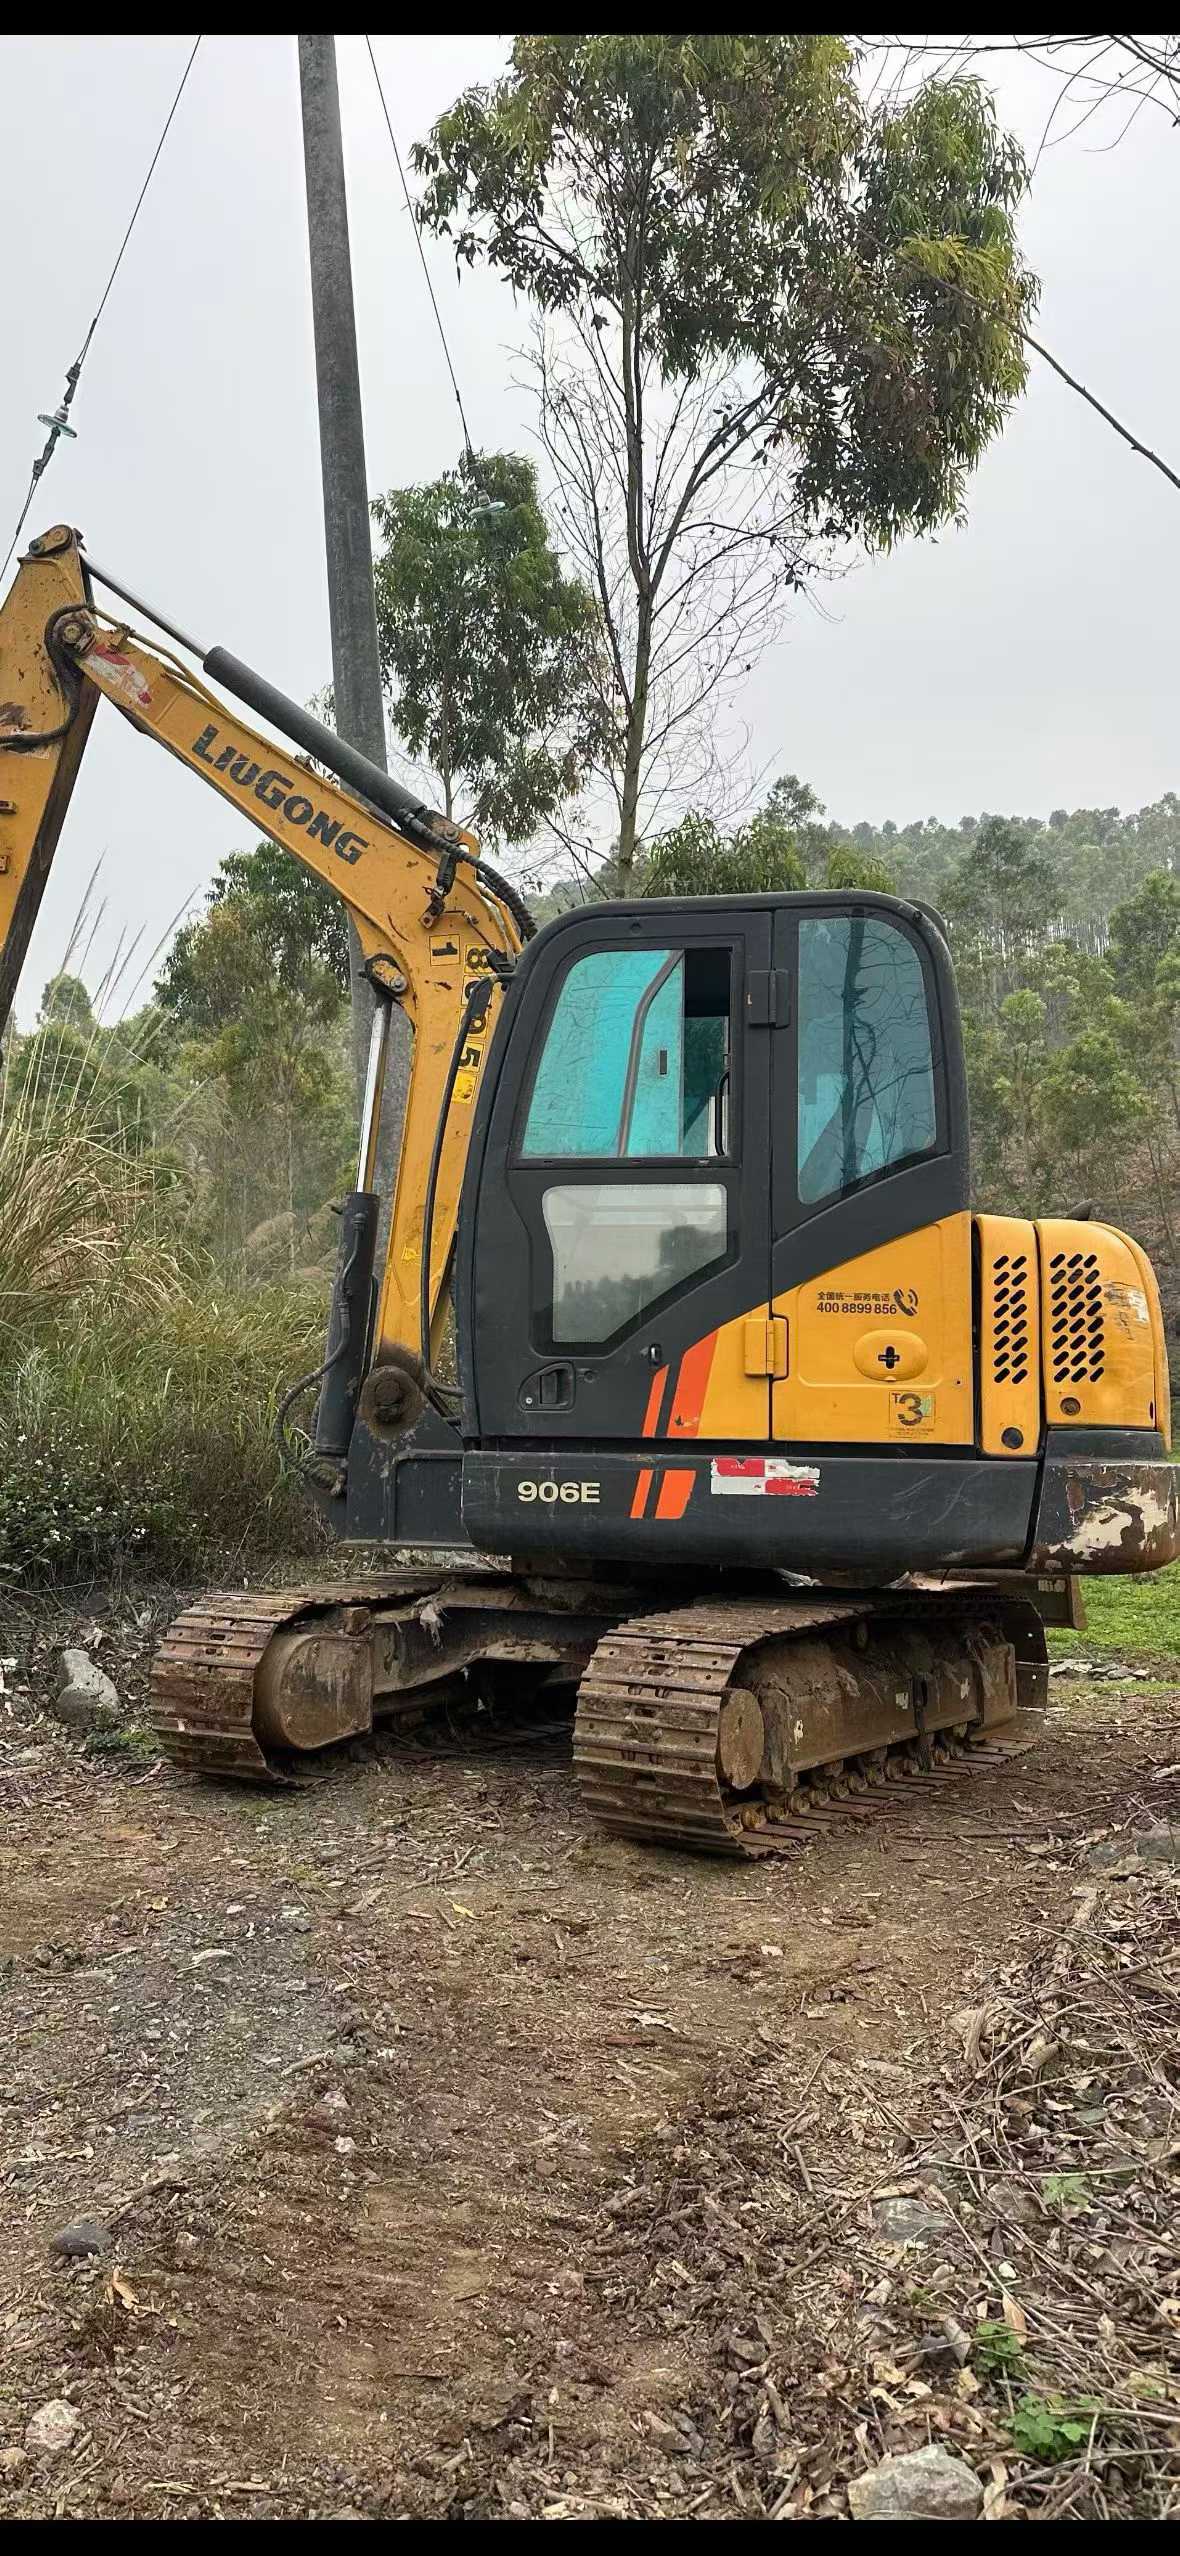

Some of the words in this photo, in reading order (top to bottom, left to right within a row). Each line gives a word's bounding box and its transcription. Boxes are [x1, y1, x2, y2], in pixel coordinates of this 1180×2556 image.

[192, 724, 369, 866] LIUGONG
[432, 942, 458, 957] 1
[817, 1291, 890, 1302] 全国统一服务电话
[817, 1302, 839, 1313] 400
[842, 1303, 872, 1313] 8899
[874, 1304, 897, 1314] 856
[517, 1481, 600, 1503] 906E
